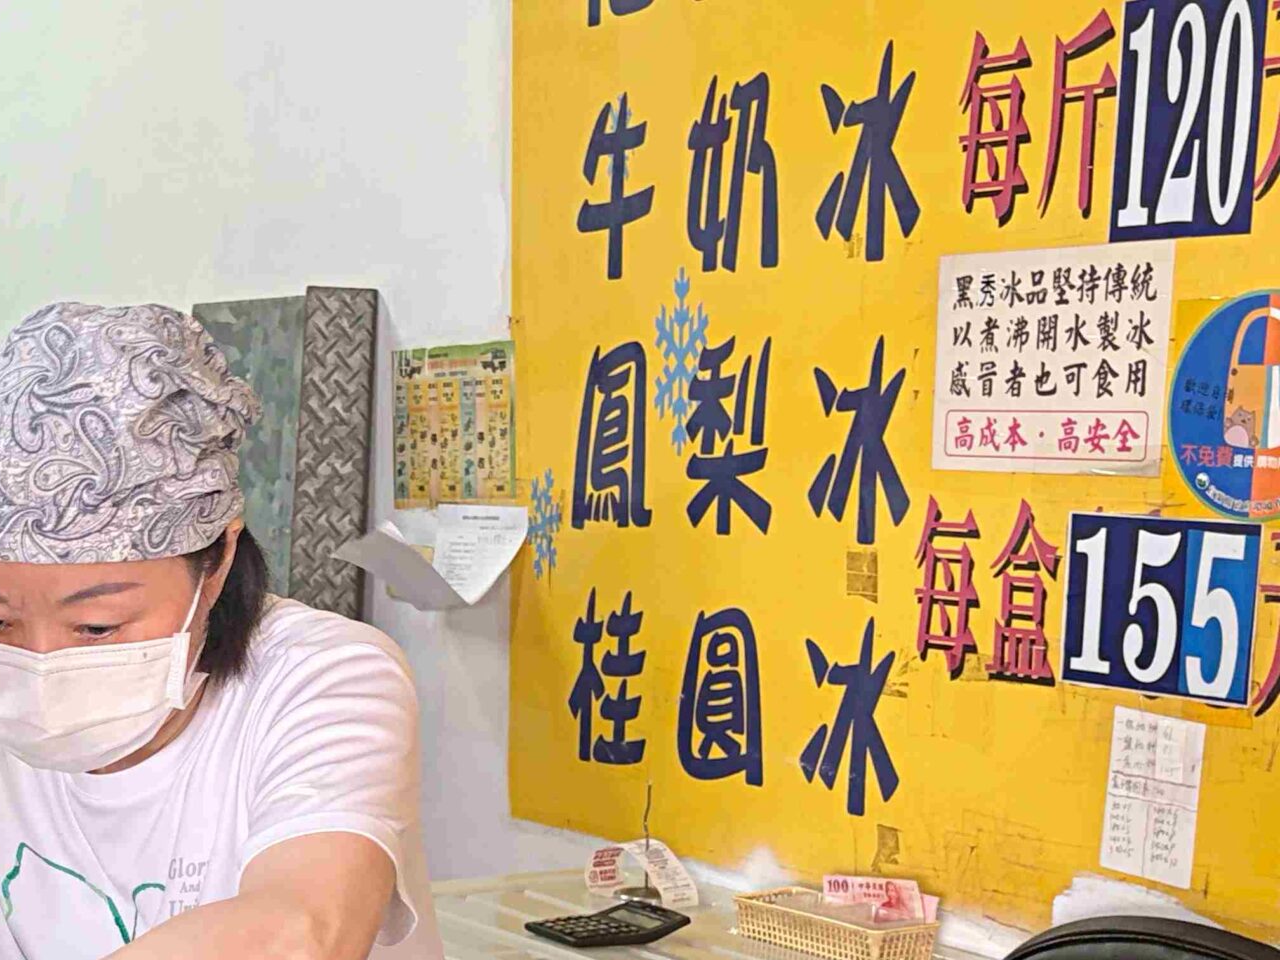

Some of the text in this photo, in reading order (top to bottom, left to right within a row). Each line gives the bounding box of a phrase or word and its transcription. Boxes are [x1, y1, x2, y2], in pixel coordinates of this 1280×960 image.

[576, 40, 920, 280] 牛奶冰
[952, 261, 1158, 310] 黑秀冰品堅持傳統
[952, 311, 1155, 354] 以煮沸開水製冰
[571, 334, 911, 545] 鳳梨冰
[568, 586, 900, 817] 桂圓冰
[827, 879, 849, 893] 100
